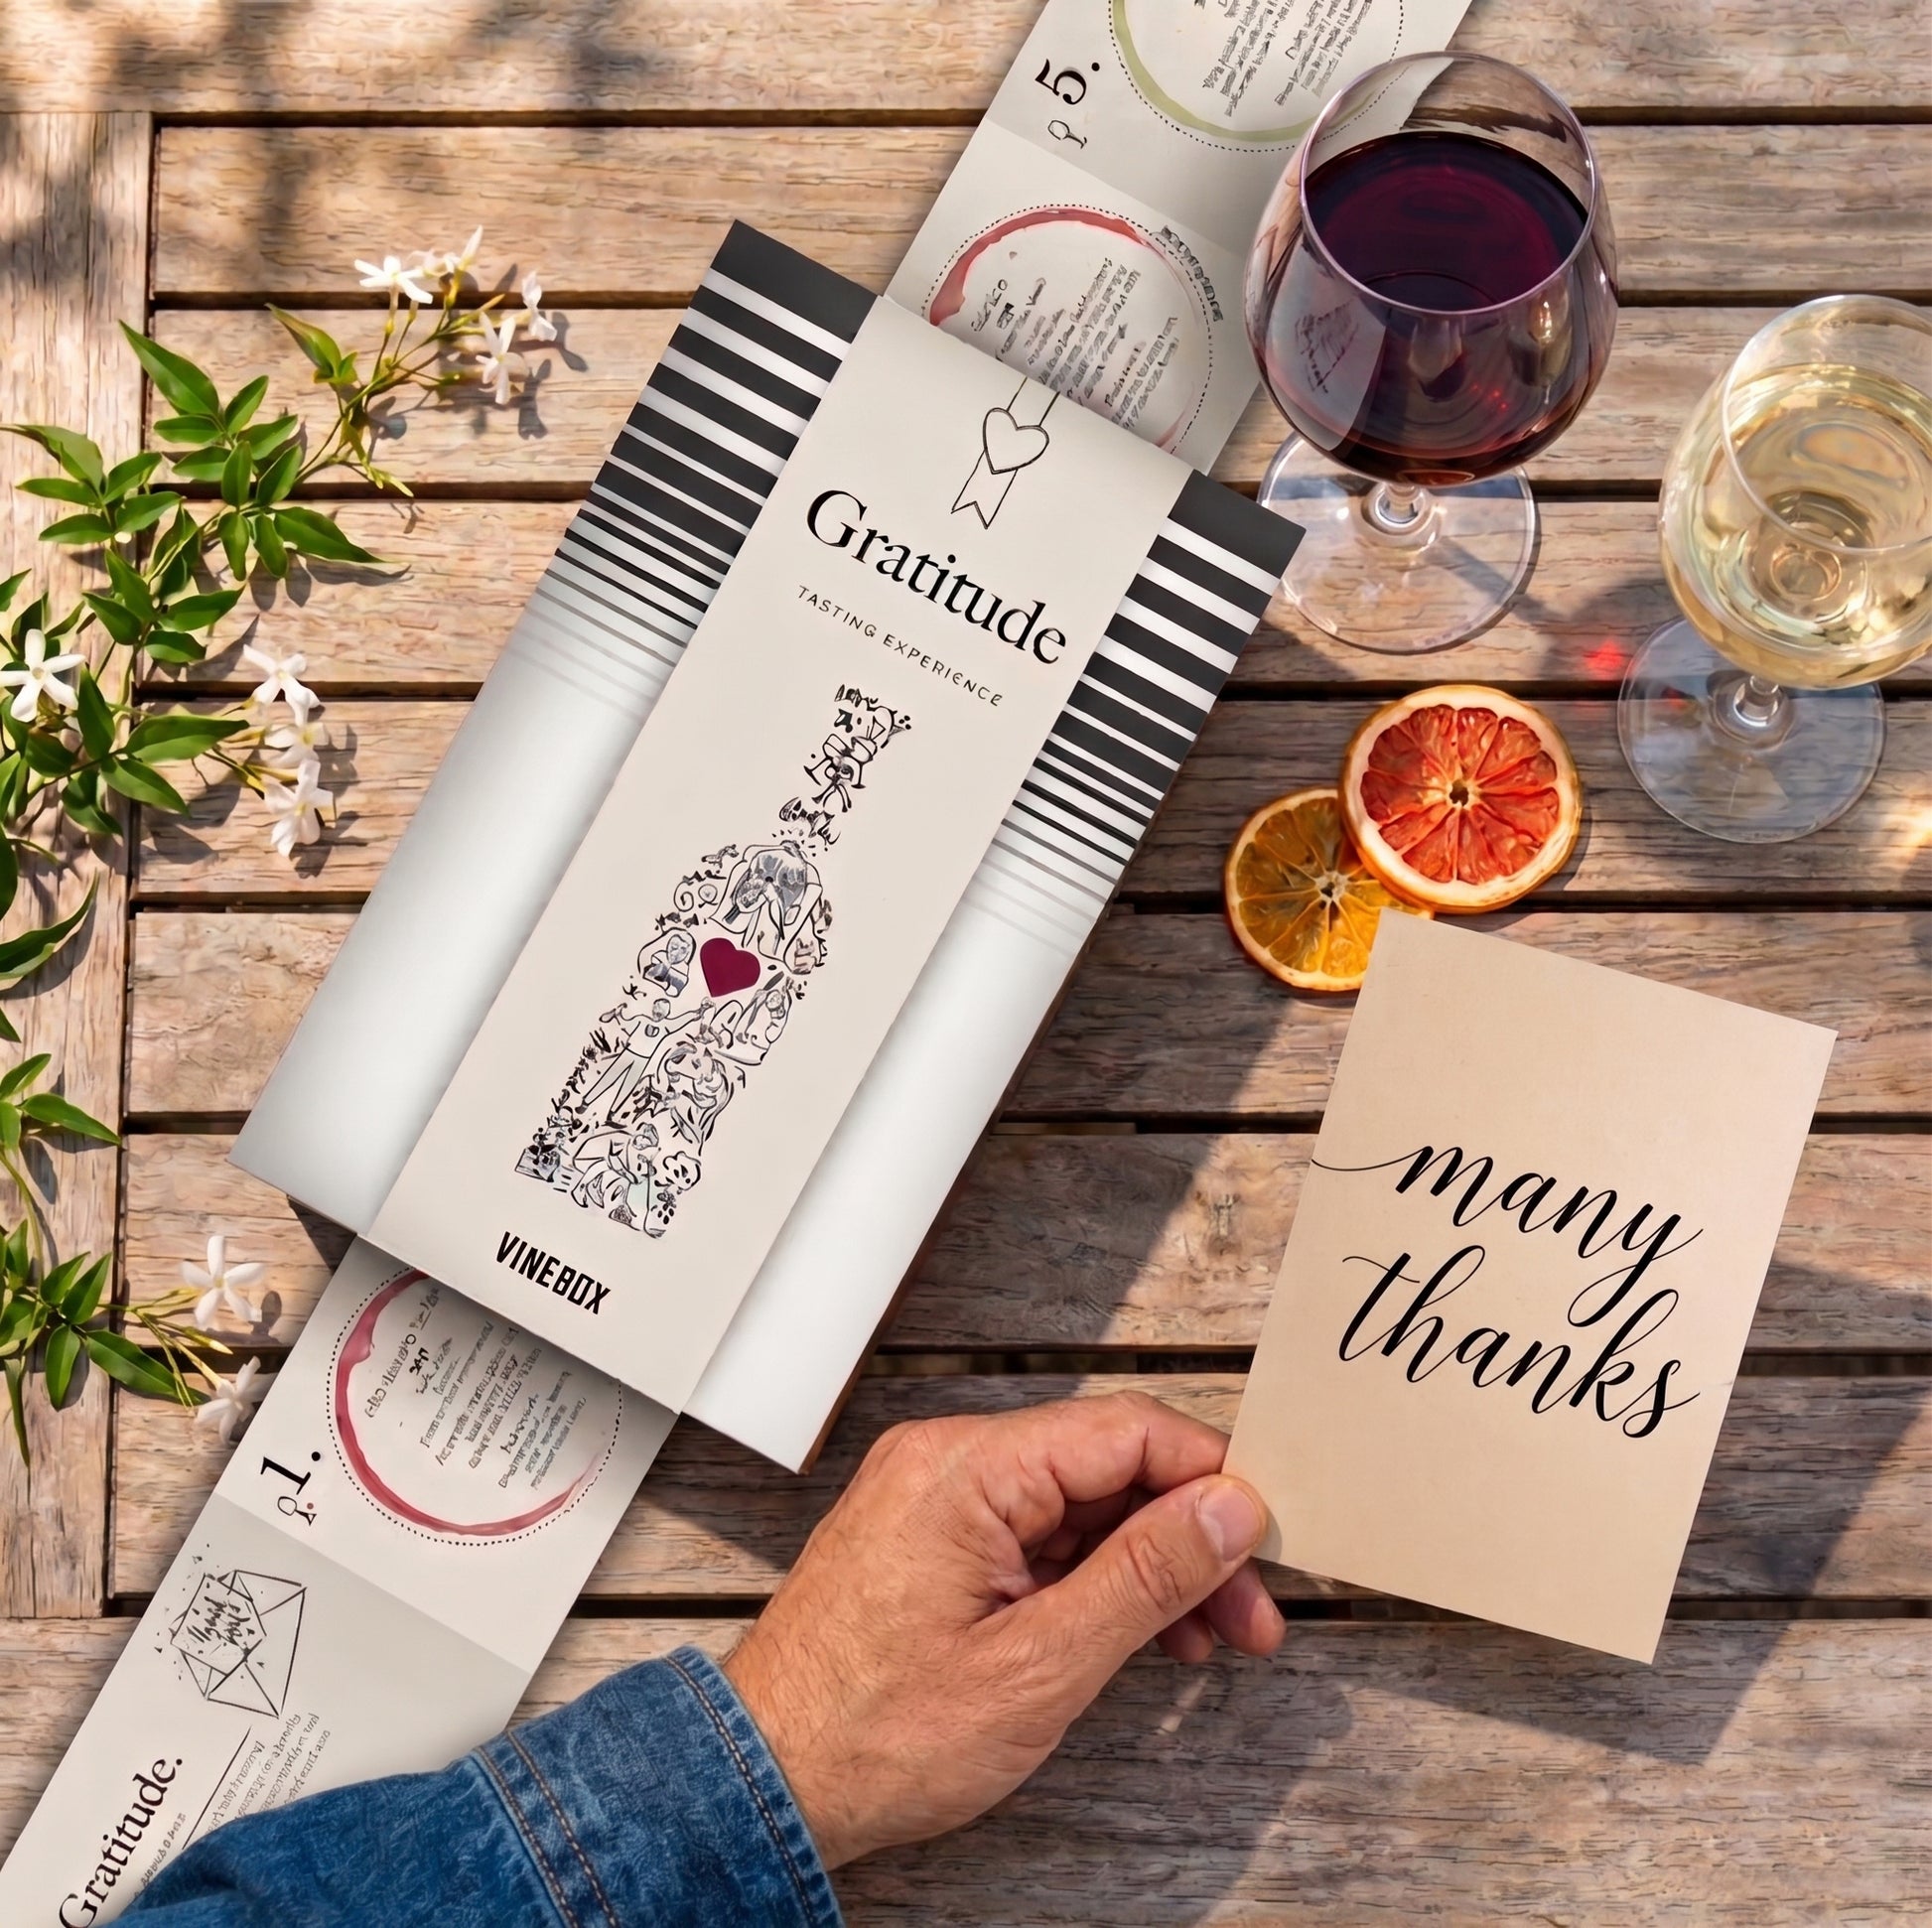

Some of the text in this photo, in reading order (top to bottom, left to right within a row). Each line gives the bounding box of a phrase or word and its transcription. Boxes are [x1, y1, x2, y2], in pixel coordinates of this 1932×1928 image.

[1035, 58, 1100, 105] 5.
[798, 585, 1003, 707] TASTING EXPERIENCE
[806, 489, 1066, 664] Gratitude
[496, 1231, 612, 1314] VINEBOX
[1311, 1146, 1704, 1327] many
[1338, 1244, 1701, 1438] thanks
[260, 1450, 321, 1495] 1.
[59, 1758, 183, 1928] Gratitude.
